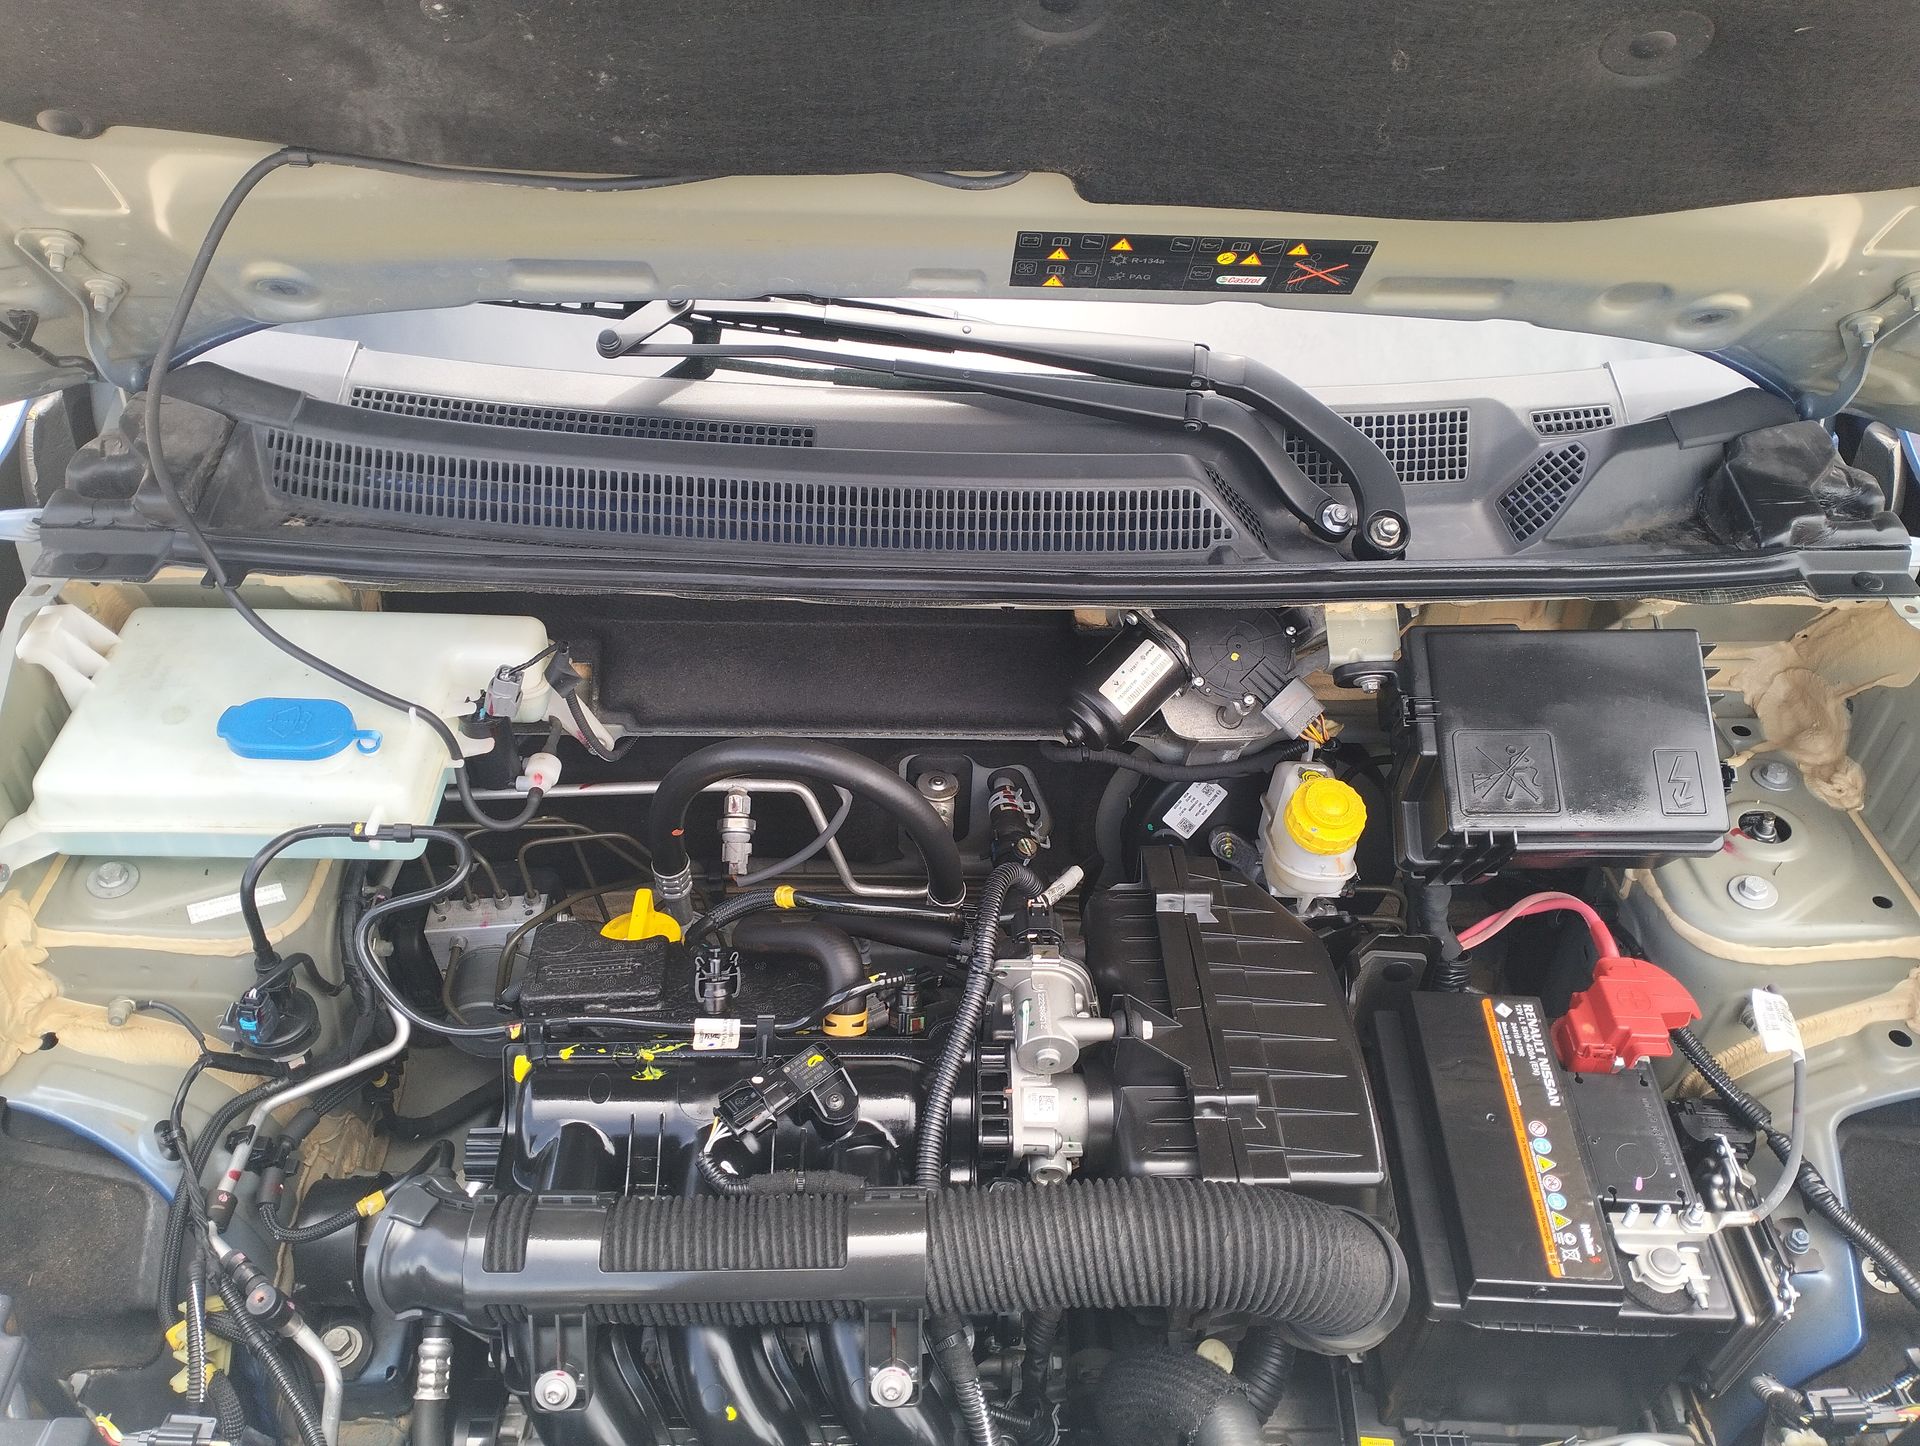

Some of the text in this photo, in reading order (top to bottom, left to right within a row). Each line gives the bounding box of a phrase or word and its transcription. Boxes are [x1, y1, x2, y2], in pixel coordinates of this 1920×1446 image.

[1131, 257, 1165, 265] R-134a
[1227, 276, 1262, 285] Castrol
[1522, 1003, 1561, 1106] RENAULT NISSAN
